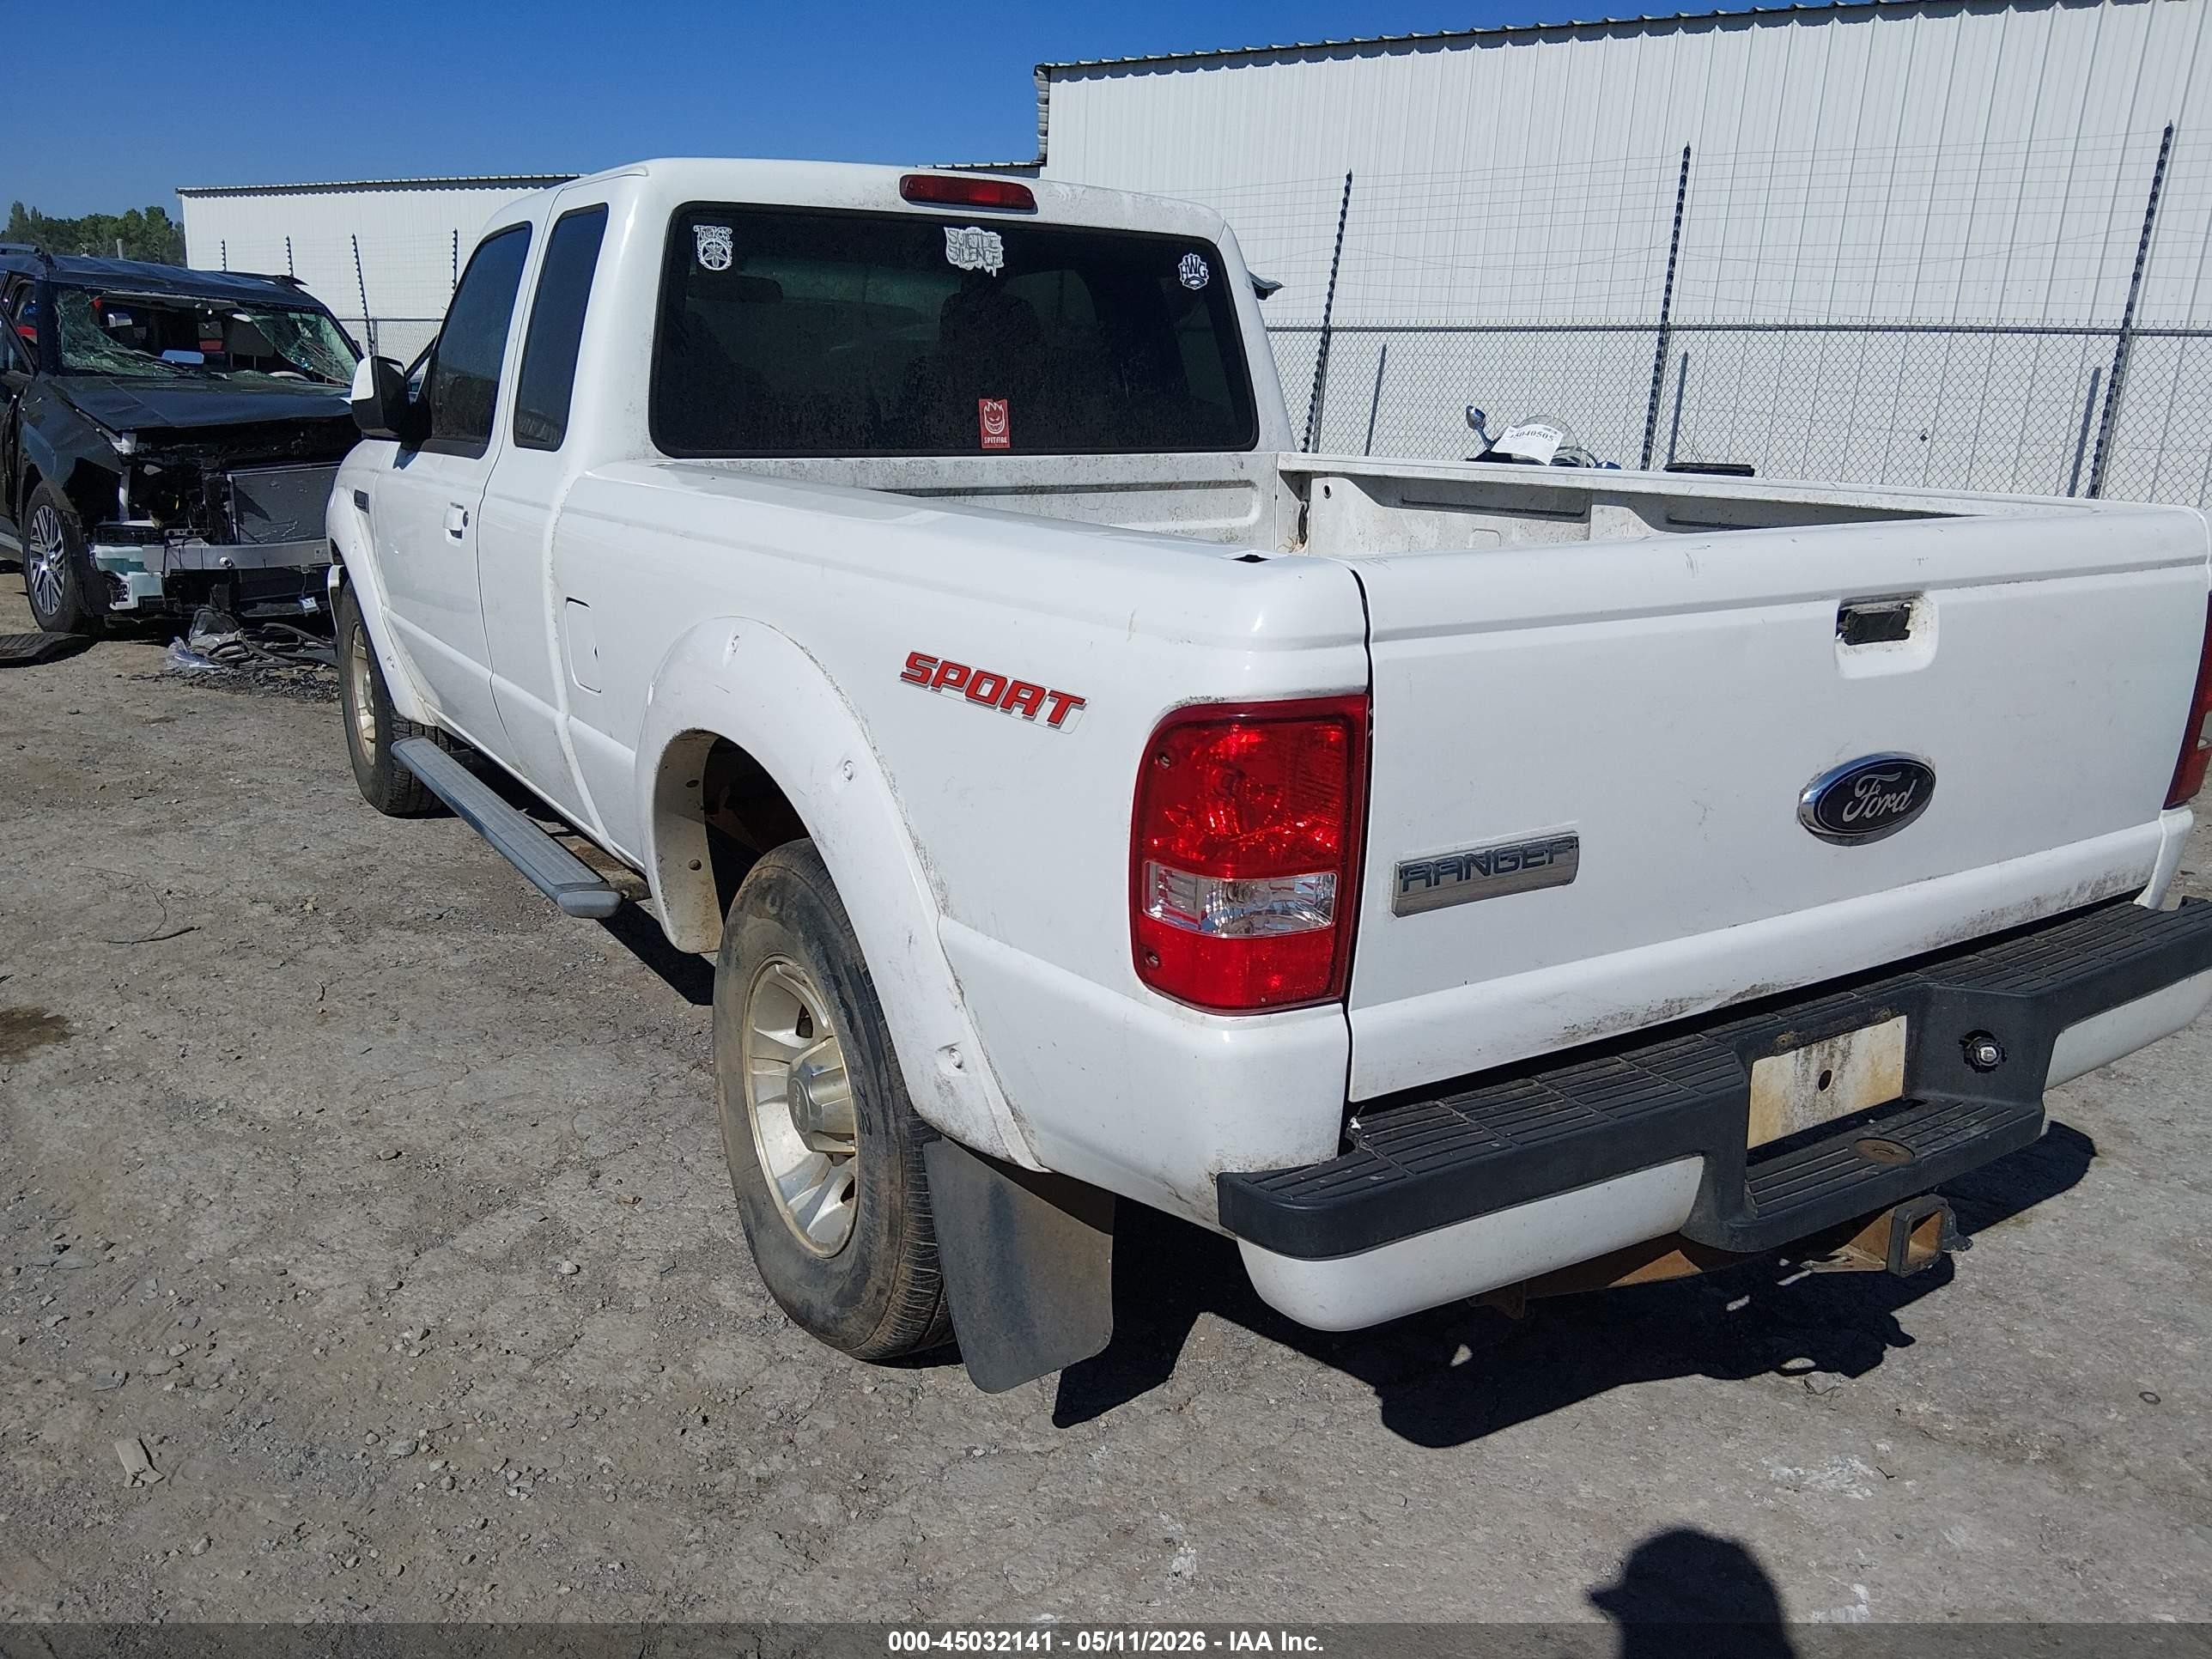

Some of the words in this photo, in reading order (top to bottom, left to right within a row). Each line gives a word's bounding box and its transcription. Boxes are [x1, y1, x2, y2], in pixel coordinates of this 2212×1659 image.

[1179, 254, 1208, 281] HWG
[900, 650, 1088, 730] SPORT
[1842, 772, 1917, 823] Ford
[1399, 836, 1579, 892] RANGER
